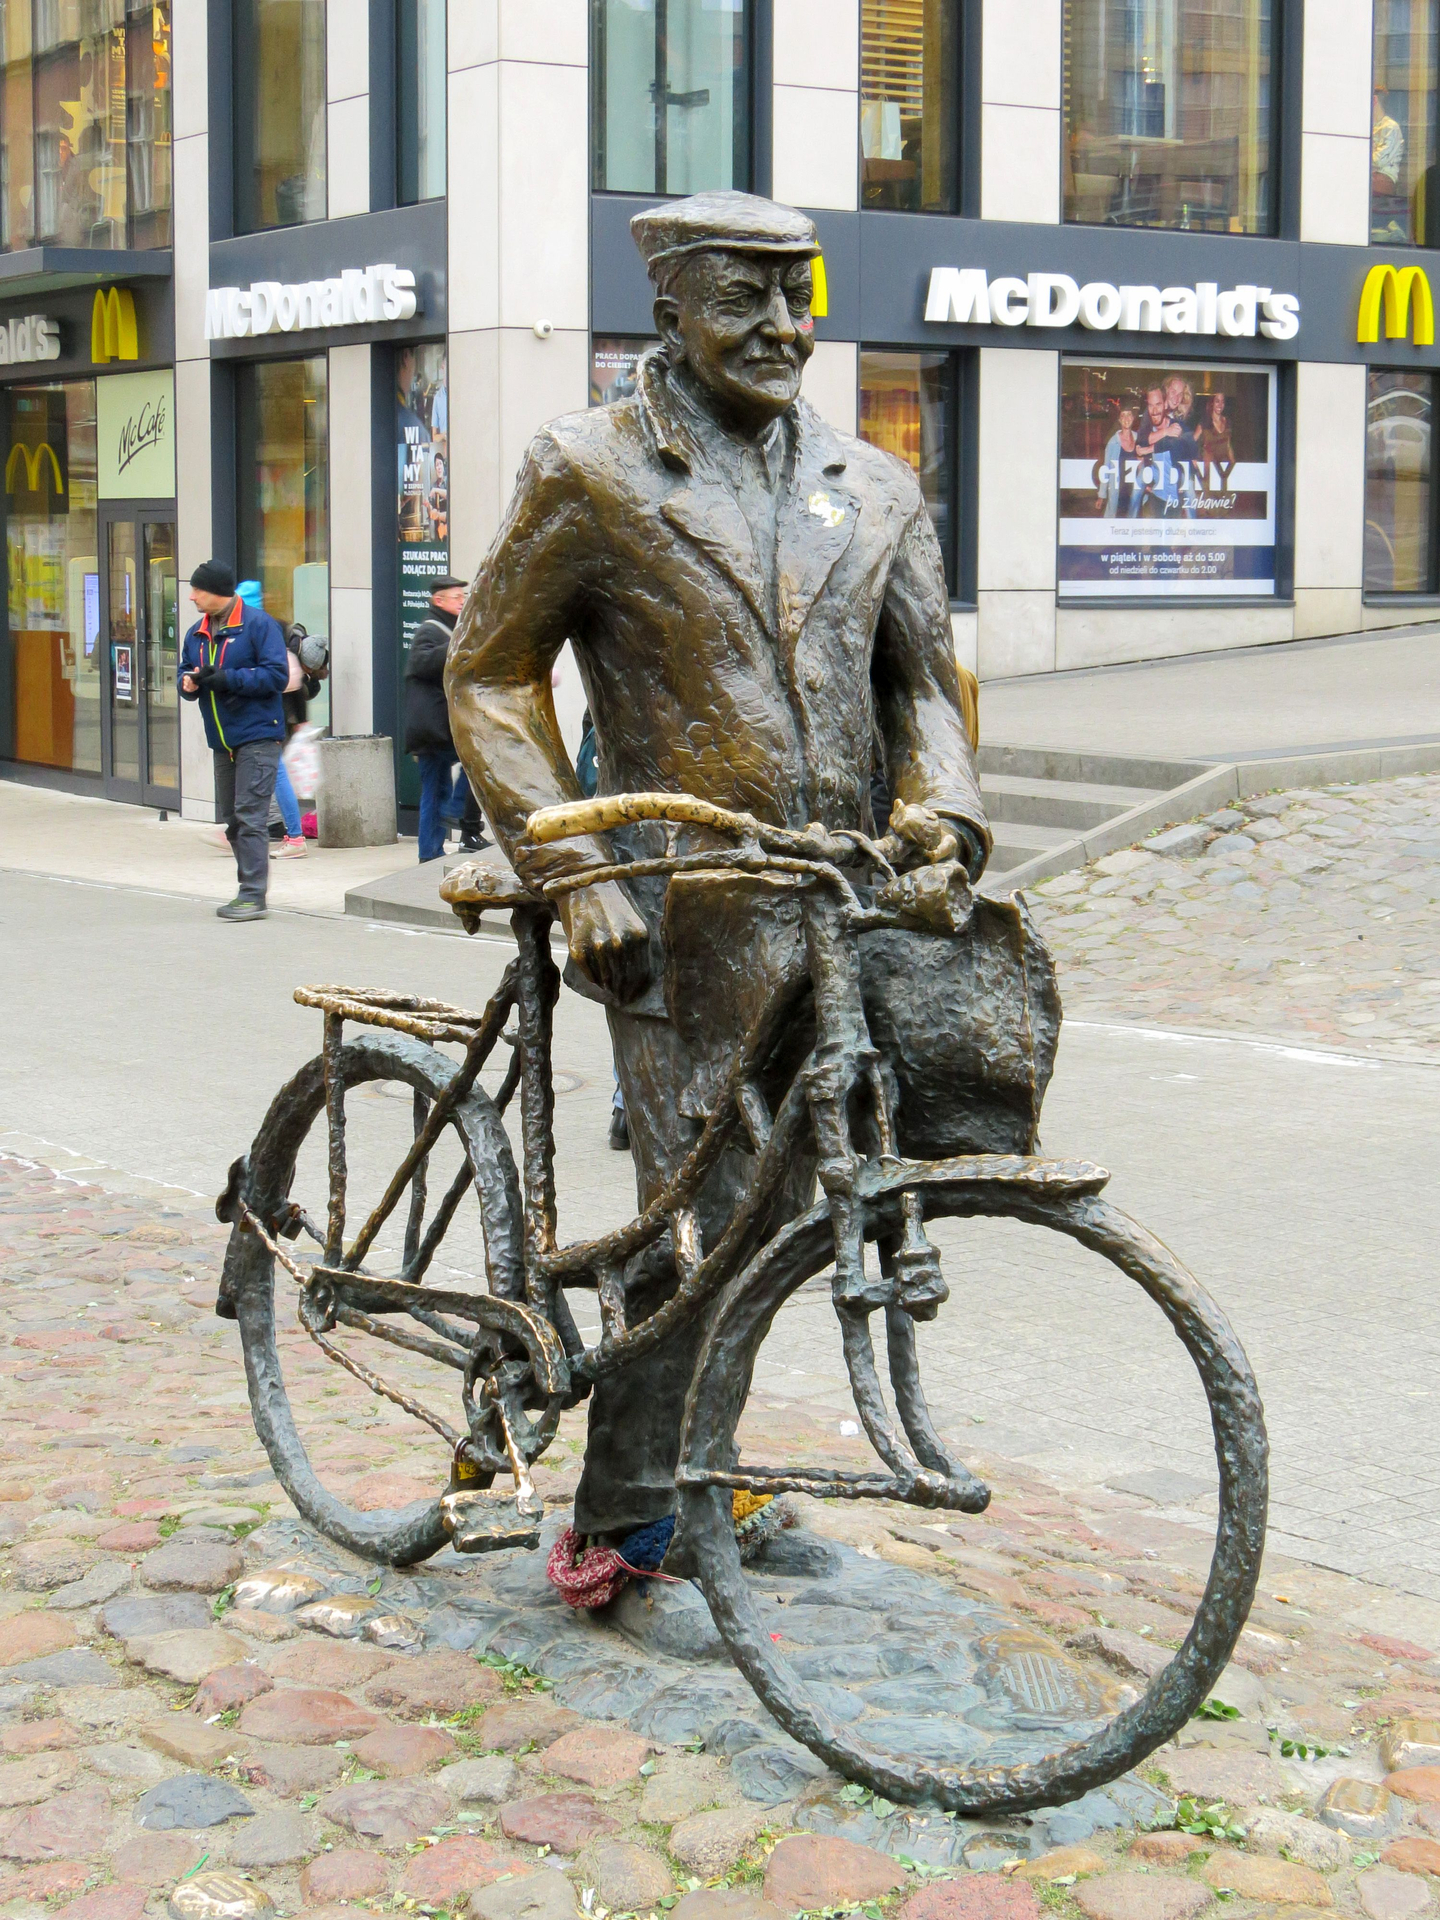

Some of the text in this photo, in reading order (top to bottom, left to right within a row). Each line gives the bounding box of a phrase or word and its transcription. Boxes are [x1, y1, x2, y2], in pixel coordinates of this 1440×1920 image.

[204, 263, 416, 340] McDonald's
[924, 266, 1300, 340] McDonald's
[595, 352, 618, 360] PRACA
[118, 395, 166, 465] McCafé
[404, 426, 419, 444] WI
[410, 444, 424, 462] TA
[403, 463, 421, 482] MY
[1091, 459, 1236, 491] GŁODNY
[1163, 492, 1237, 515] po zabawie?
[1110, 526, 1130, 536] Teraz
[1165, 526, 1187, 538] dłużej
[402, 550, 430, 561] SZUKASZ
[1100, 554, 1109, 562] w
[1110, 552, 1137, 564] piątek
[1143, 554, 1151, 562] w
[1152, 552, 1181, 564] sobotę
[1183, 552, 1193, 562] aż
[1195, 552, 1206, 562] do
[1208, 552, 1226, 562] 5.00
[402, 564, 427, 577] DOŁĄCZ
[426, 564, 437, 575] DO
[1109, 565, 1119, 574] od
[1149, 566, 1158, 574] do
[1190, 566, 1200, 574] do
[1201, 566, 1217, 574] 2.00
